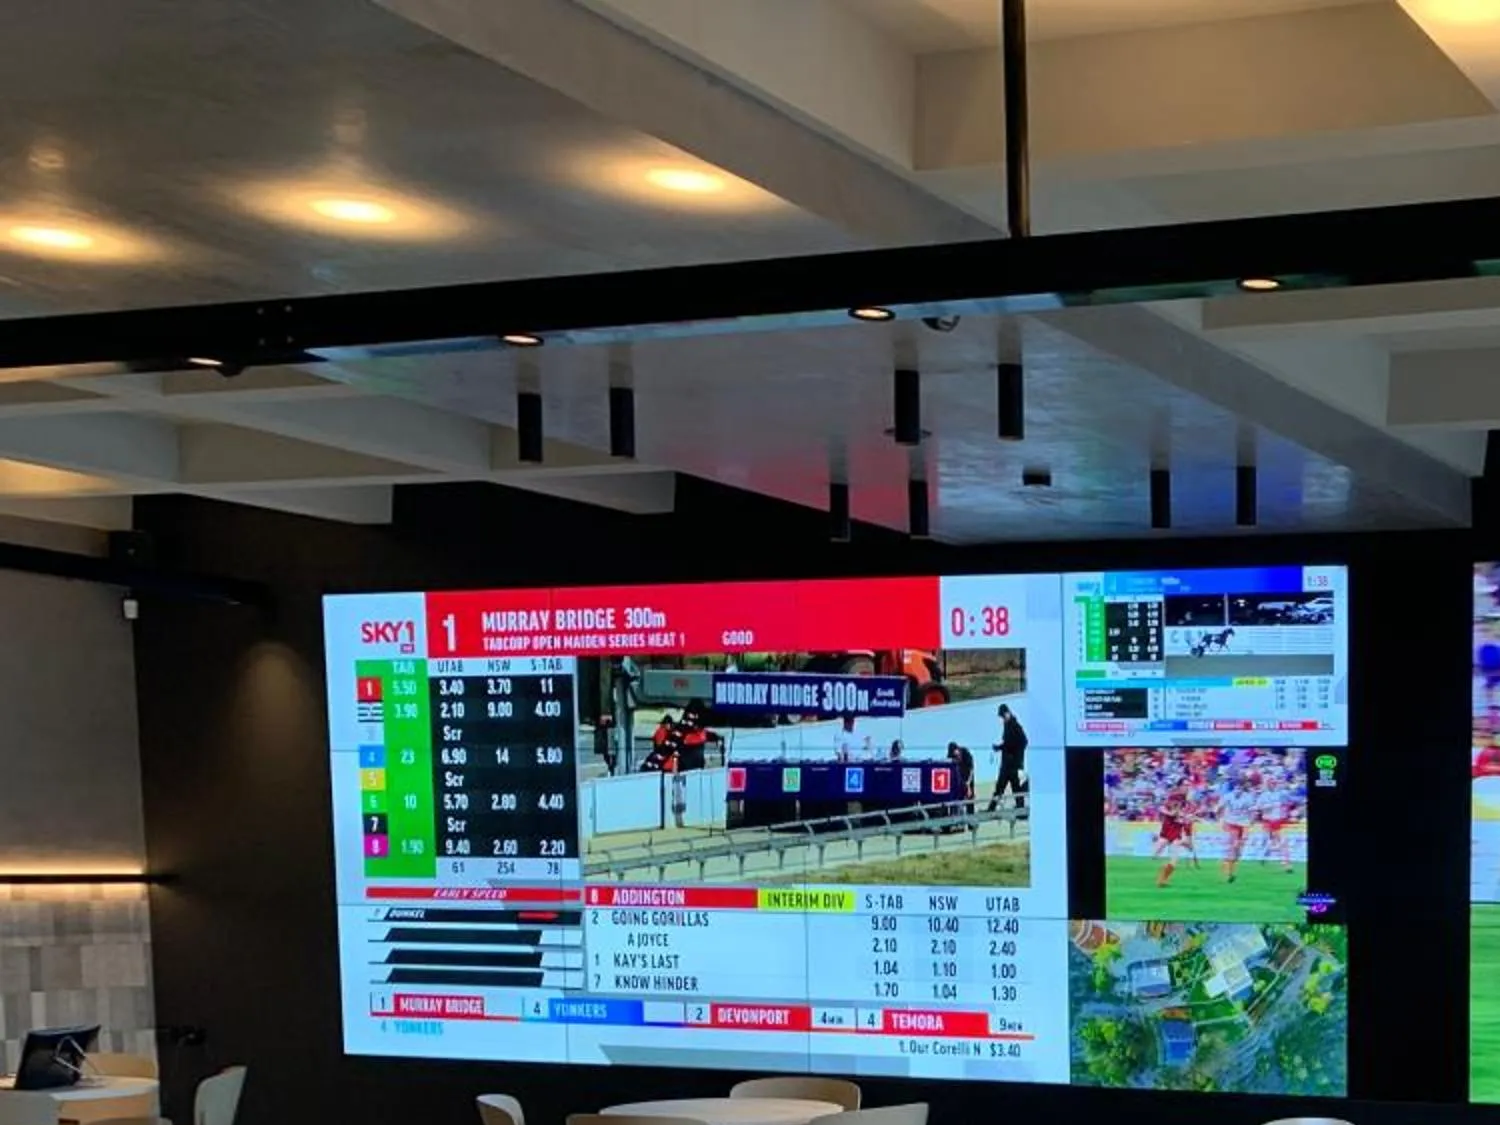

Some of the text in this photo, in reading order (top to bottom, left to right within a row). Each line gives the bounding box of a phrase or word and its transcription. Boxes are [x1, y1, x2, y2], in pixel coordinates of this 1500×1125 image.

[481, 608, 666, 632] MURRAY BRIDGE 300m
[951, 606, 1010, 636] 0:38
[361, 620, 415, 643] SKY1
[442, 613, 456, 651] 1
[483, 636, 531, 651] TABCORP
[533, 635, 562, 650] OPEN
[563, 635, 606, 649] MAIDEN
[608, 633, 645, 648] SERIES
[648, 632, 676, 647] HEAT
[437, 658, 563, 673] UTAB NSW S-TAB
[487, 679, 512, 695] 3.70
[540, 678, 553, 694] 11
[715, 681, 768, 705] MURRAY
[440, 702, 465, 718] 2.10
[443, 725, 463, 741] Scr
[495, 748, 510, 764] 14
[445, 771, 464, 787] Scr
[443, 794, 469, 810] 5.70
[370, 816, 466, 832] 7 Scr
[540, 839, 565, 855] 2.20
[612, 889, 686, 905] ADDINGTON
[767, 892, 845, 909] INTERIM DIV
[865, 894, 1021, 912] S-TAB NSW UTAB
[591, 911, 599, 925] 2
[611, 911, 649, 926] GOING
[652, 912, 710, 927] GORILLAS
[927, 916, 960, 933] 10.40
[987, 917, 1019, 934] 12.40
[628, 933, 669, 948] A JOYCE
[872, 938, 1016, 956] 2.10 2.10 2.40
[613, 953, 648, 969] KAY'S
[651, 954, 680, 970] LAST
[874, 960, 898, 975] 1.04
[932, 961, 957, 977] 1.10
[991, 963, 1017, 979] 1.00
[594, 975, 1017, 1001] 7 KNOW HINDER 1.70 1.04 1.30
[399, 997, 443, 1013] MURRAY
[445, 998, 484, 1014] BRIDGE
[553, 1002, 608, 1019] YONKERS
[696, 1010, 704, 1020] 2
[717, 1007, 792, 1026] DEVONPORT
[867, 1013, 876, 1027] 4
[891, 1013, 945, 1031] TEMORA
[973, 1043, 981, 1056] N
[989, 1042, 1021, 1057] $3.40
